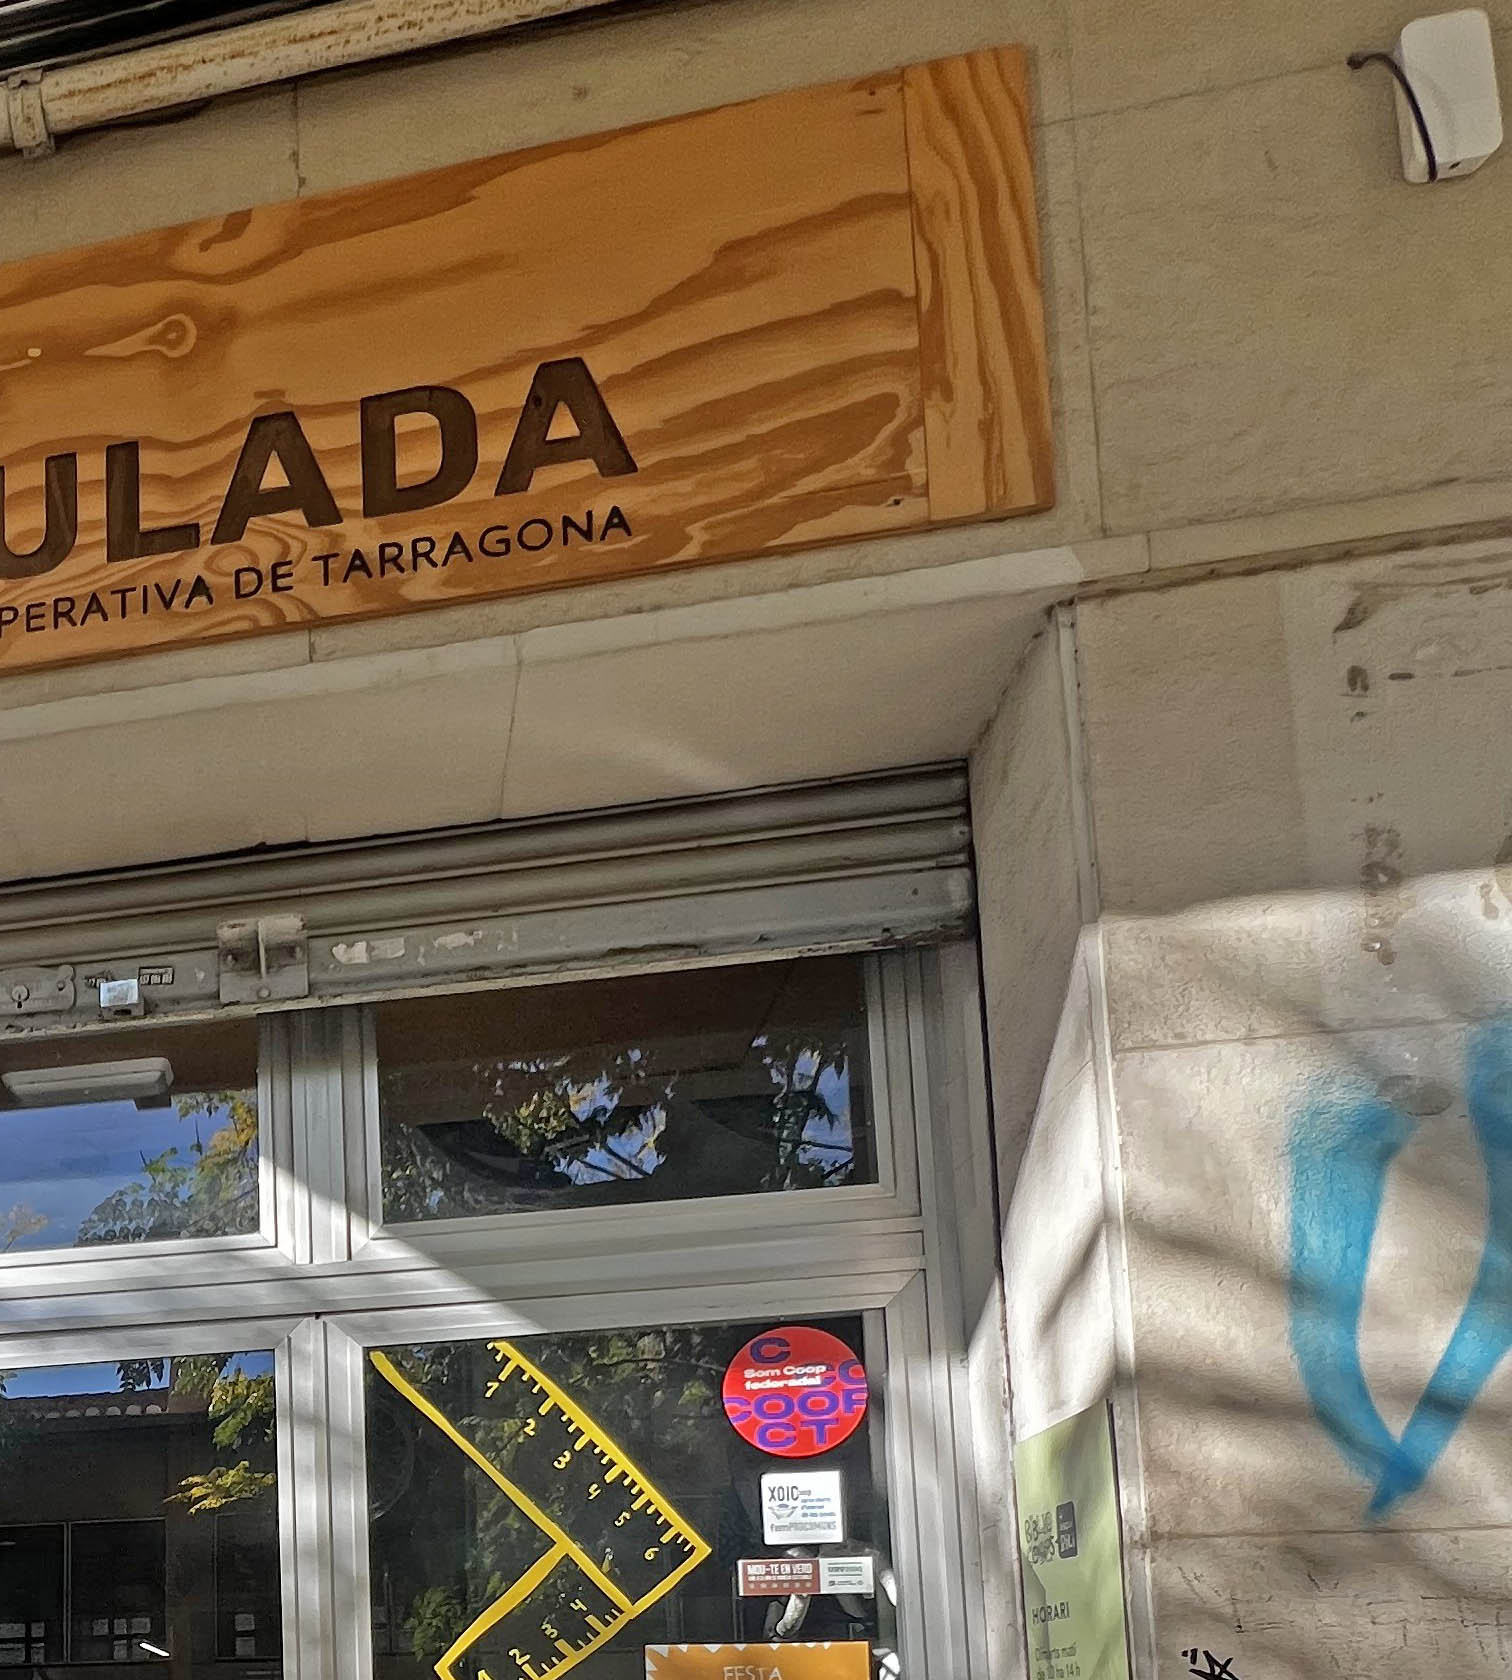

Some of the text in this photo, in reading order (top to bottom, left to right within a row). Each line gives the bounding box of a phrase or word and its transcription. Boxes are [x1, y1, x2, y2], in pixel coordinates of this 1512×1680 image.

[234, 560, 294, 600] DE
[311, 505, 634, 587] TARRAGONA
[744, 1364, 827, 1379] Som Coop
[523, 1418, 537, 1436] 2
[553, 1450, 572, 1469] 3
[614, 1511, 630, 1527] 5
[644, 1546, 659, 1561] 6
[1032, 1601, 1070, 1624] HORARI
[508, 1648, 529, 1665] 2
